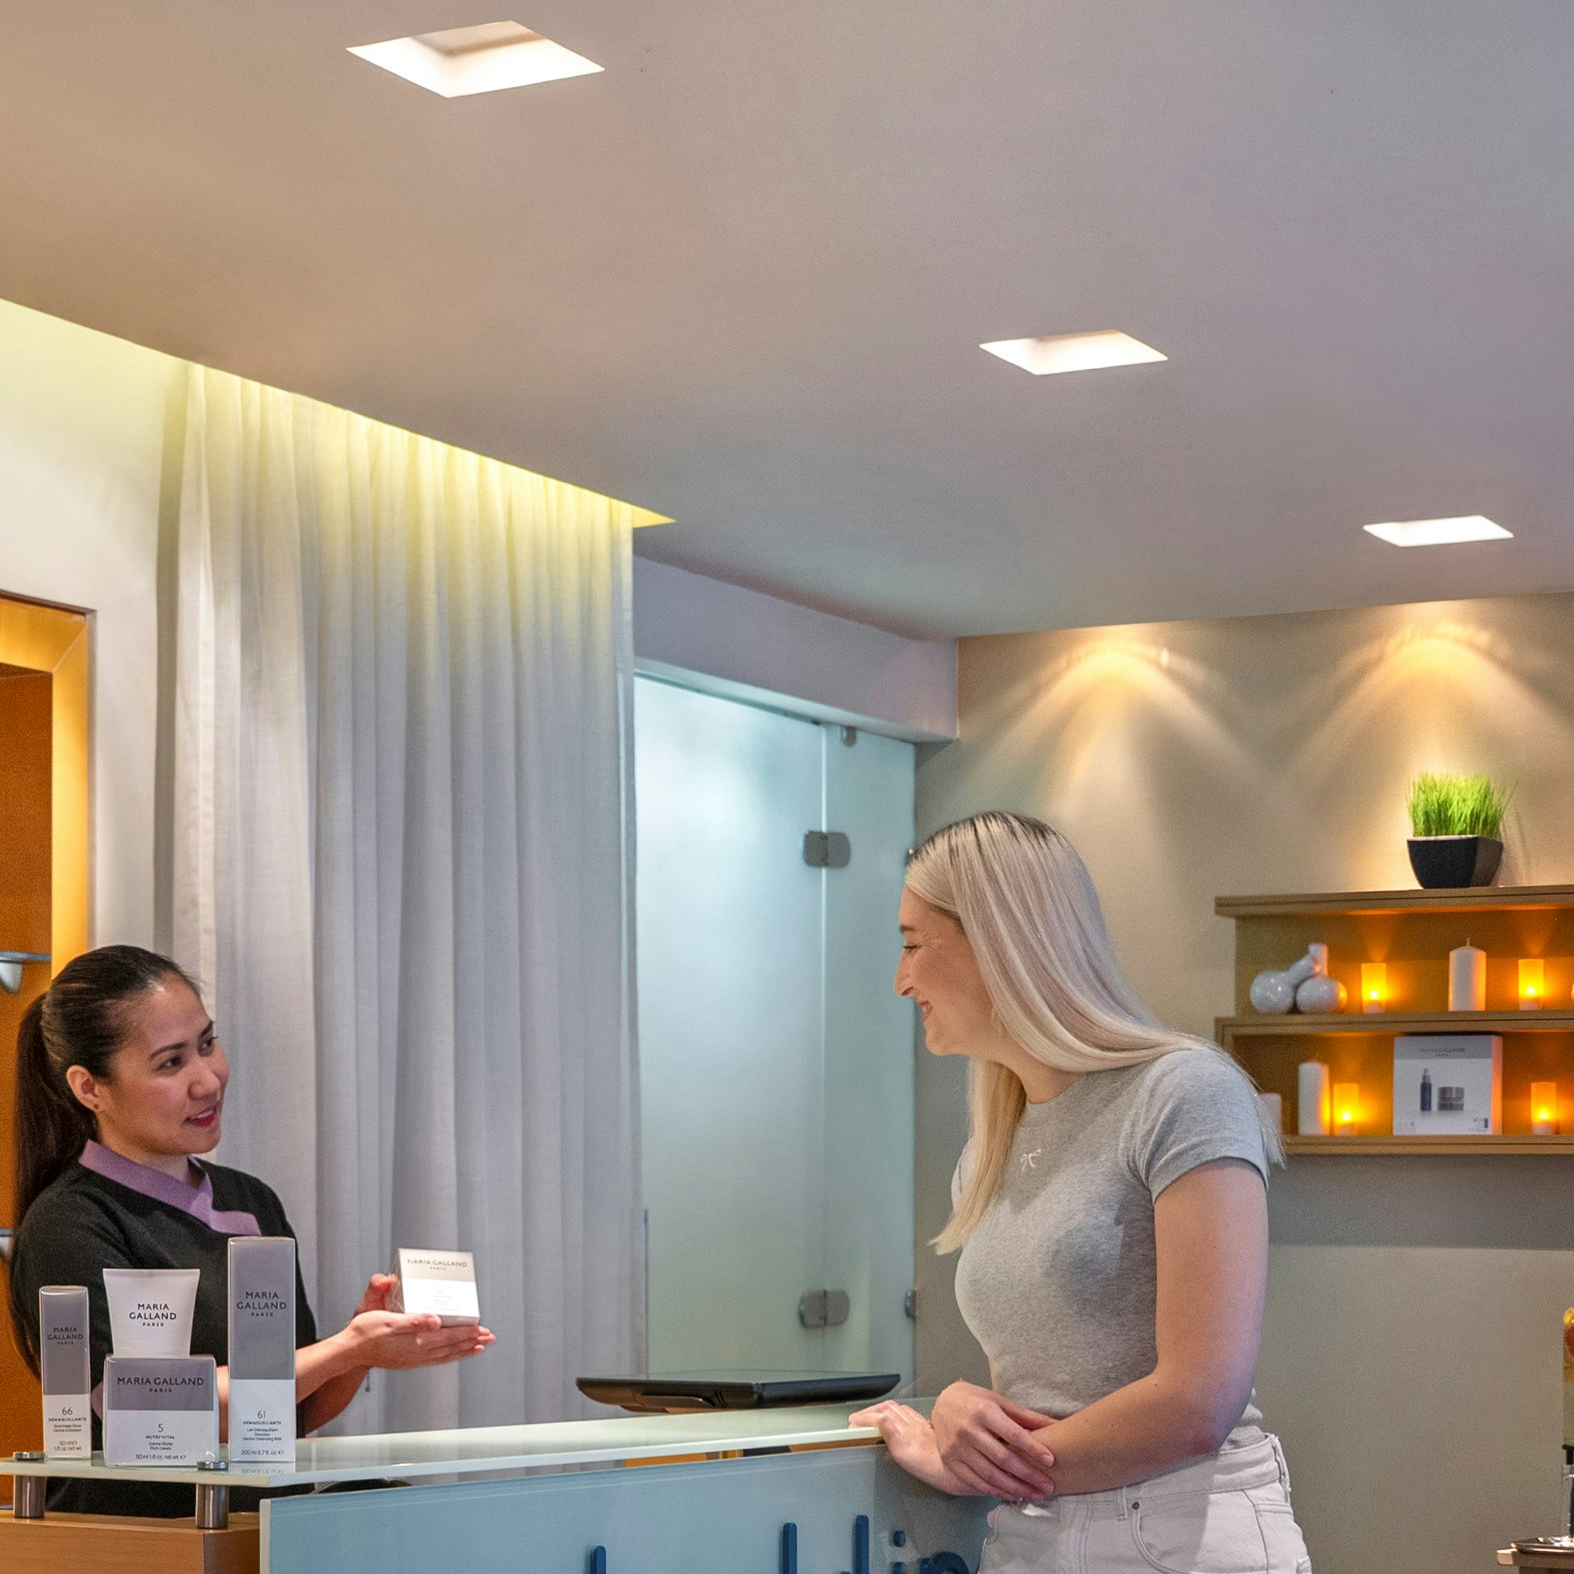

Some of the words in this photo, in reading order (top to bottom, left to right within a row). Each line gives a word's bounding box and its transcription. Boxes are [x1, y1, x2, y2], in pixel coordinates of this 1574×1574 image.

[432, 1259, 468, 1268] GALLAND
[245, 1291, 279, 1300] MARIA
[137, 1303, 170, 1311] MARIA
[236, 1301, 287, 1310] GALLAND
[129, 1312, 177, 1320] GALLAND
[117, 1377, 152, 1386] MARIA
[154, 1377, 205, 1386] GALLAND
[61, 1407, 73, 1416] 66
[257, 1410, 266, 1419] 61
[158, 1423, 164, 1433] 5
